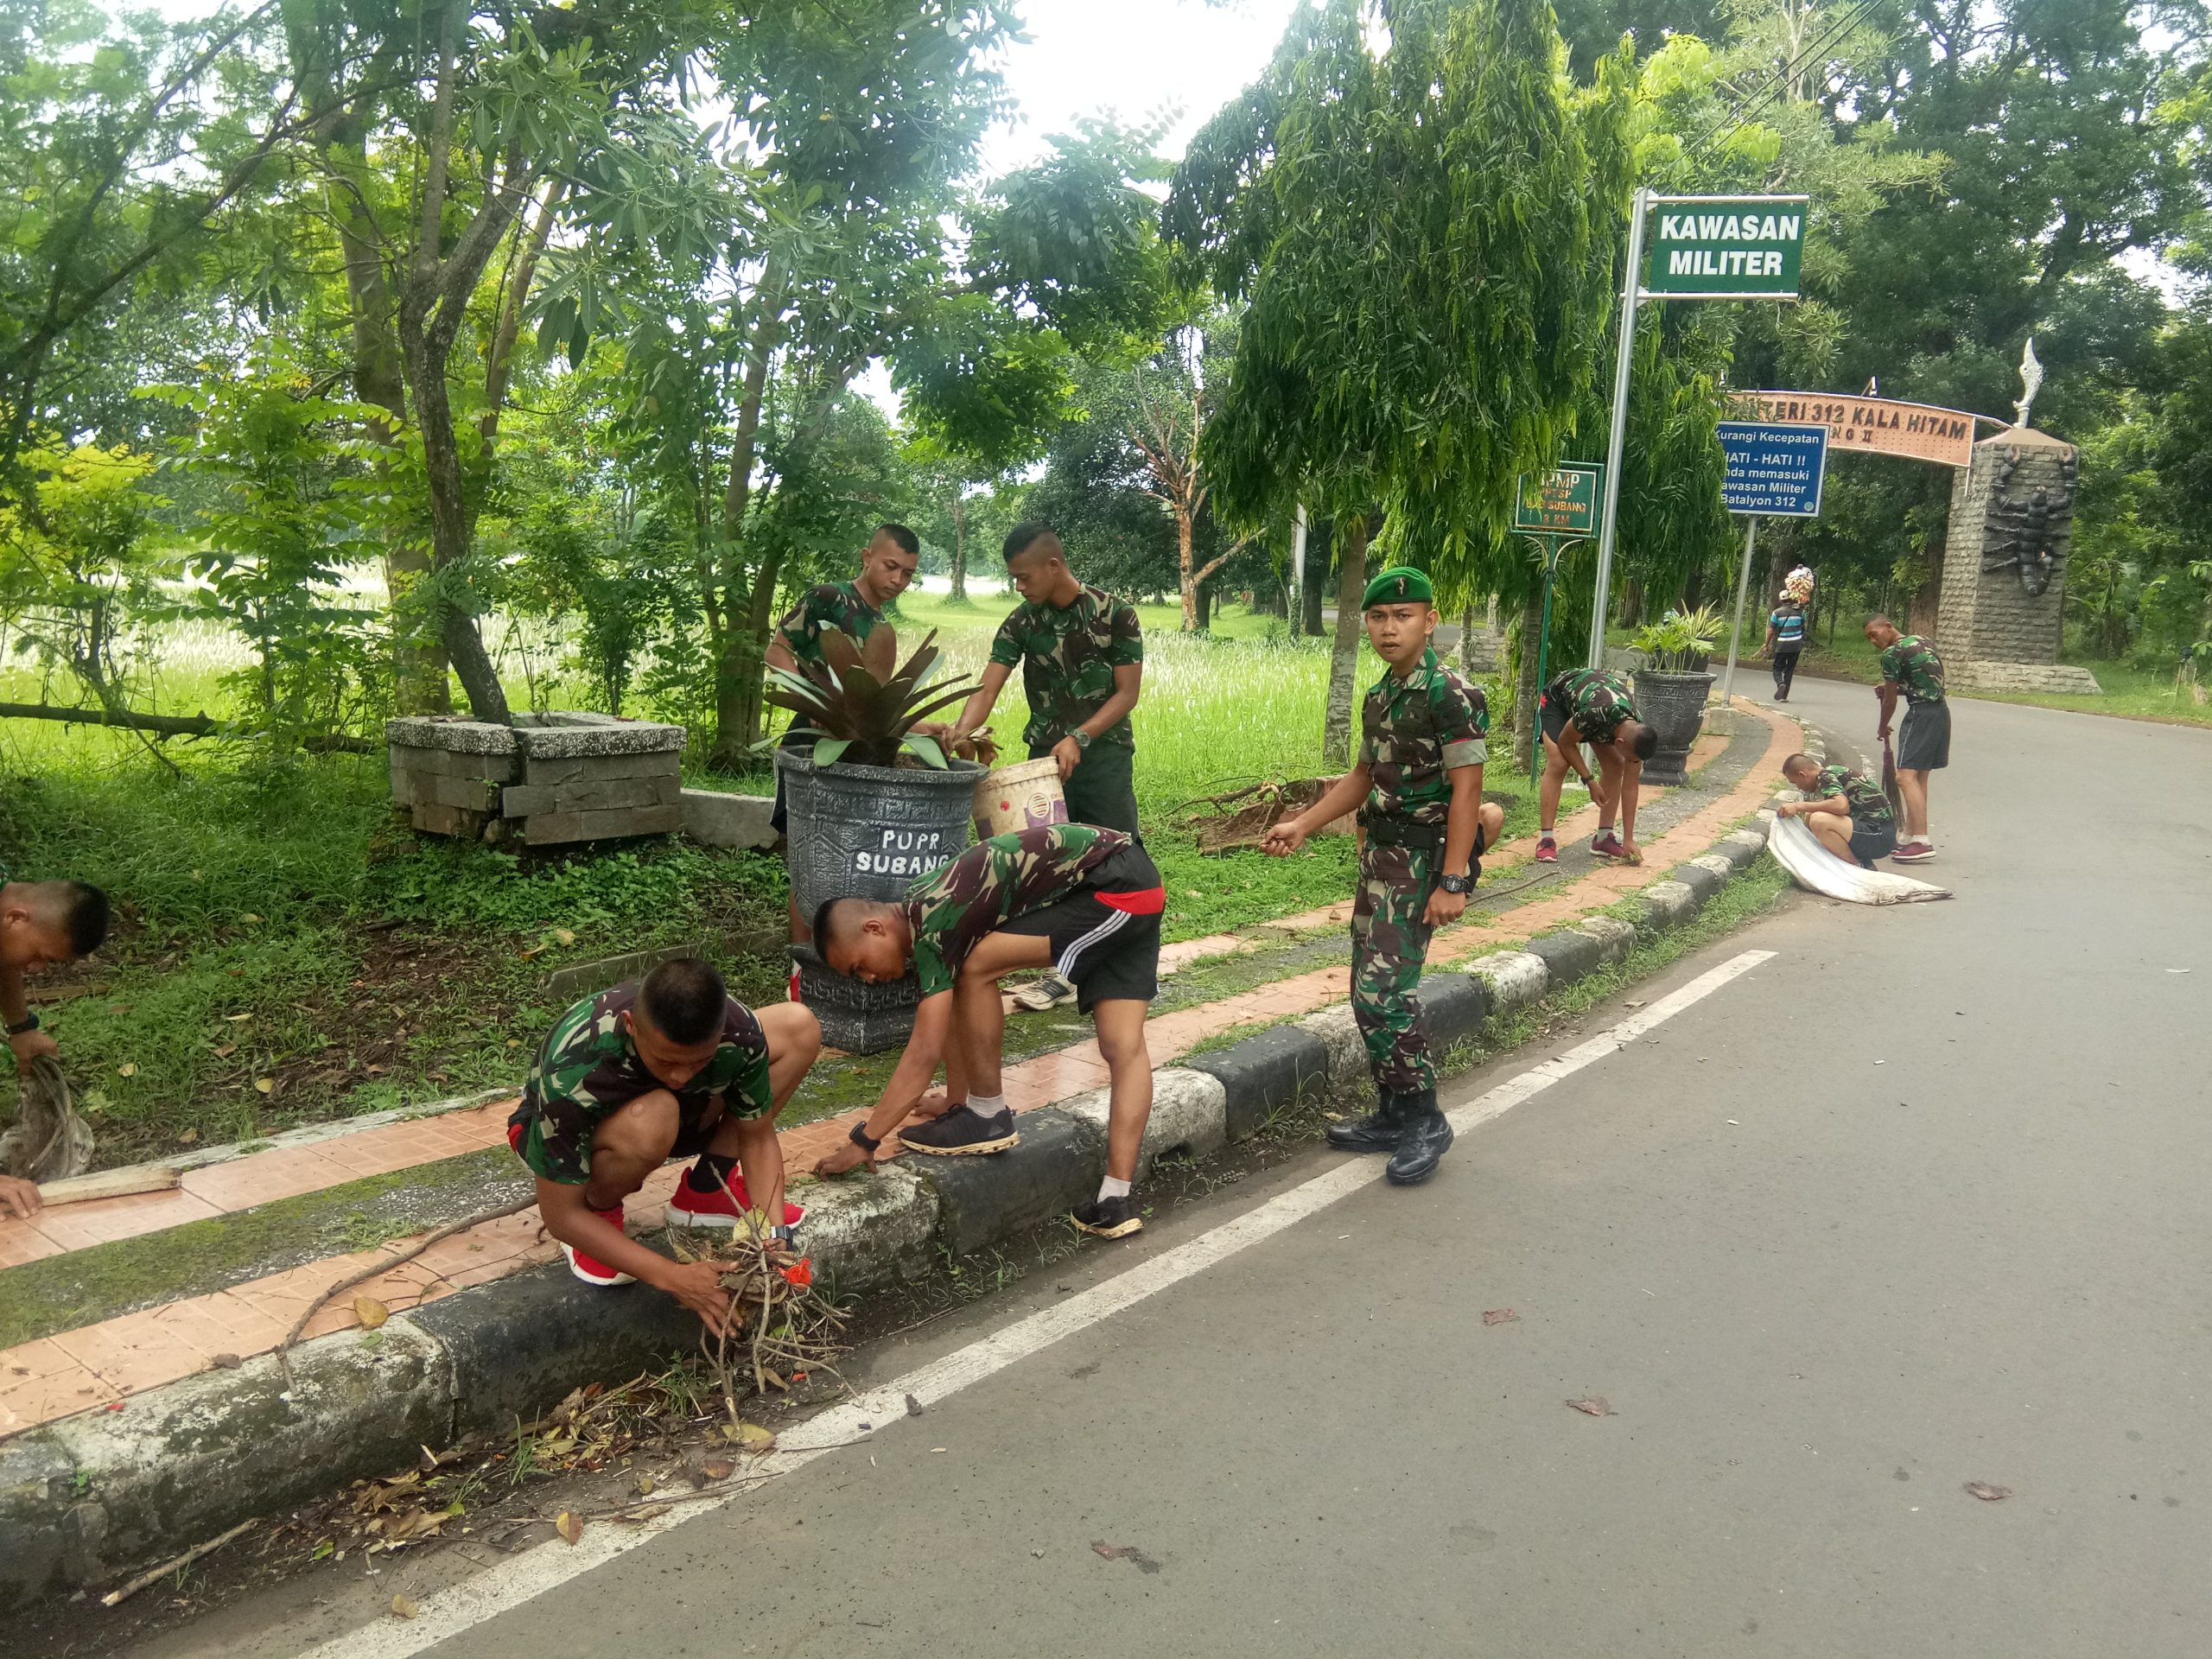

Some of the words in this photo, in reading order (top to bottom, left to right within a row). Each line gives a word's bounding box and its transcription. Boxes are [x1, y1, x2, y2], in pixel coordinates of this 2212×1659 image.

[1660, 214, 1800, 241] KAWASAN
[1669, 251, 1783, 276] MILITER
[1811, 404, 1845, 423] 312
[1852, 407, 1900, 429] KALA
[1906, 414, 1967, 441] HITAM
[1759, 432, 1819, 444] Kecepatan
[1762, 454, 1792, 466] HATI
[1796, 455, 1806, 466] !!
[1724, 467, 1745, 477] nda
[1748, 469, 1809, 480] memasuki
[1721, 481, 1765, 492] awasan
[1769, 482, 1807, 493] Militer
[1548, 501, 1586, 512] SUBANG
[1720, 494, 1771, 507] Batalyon
[1775, 497, 1796, 507] 312
[882, 830, 940, 850] PUPR
